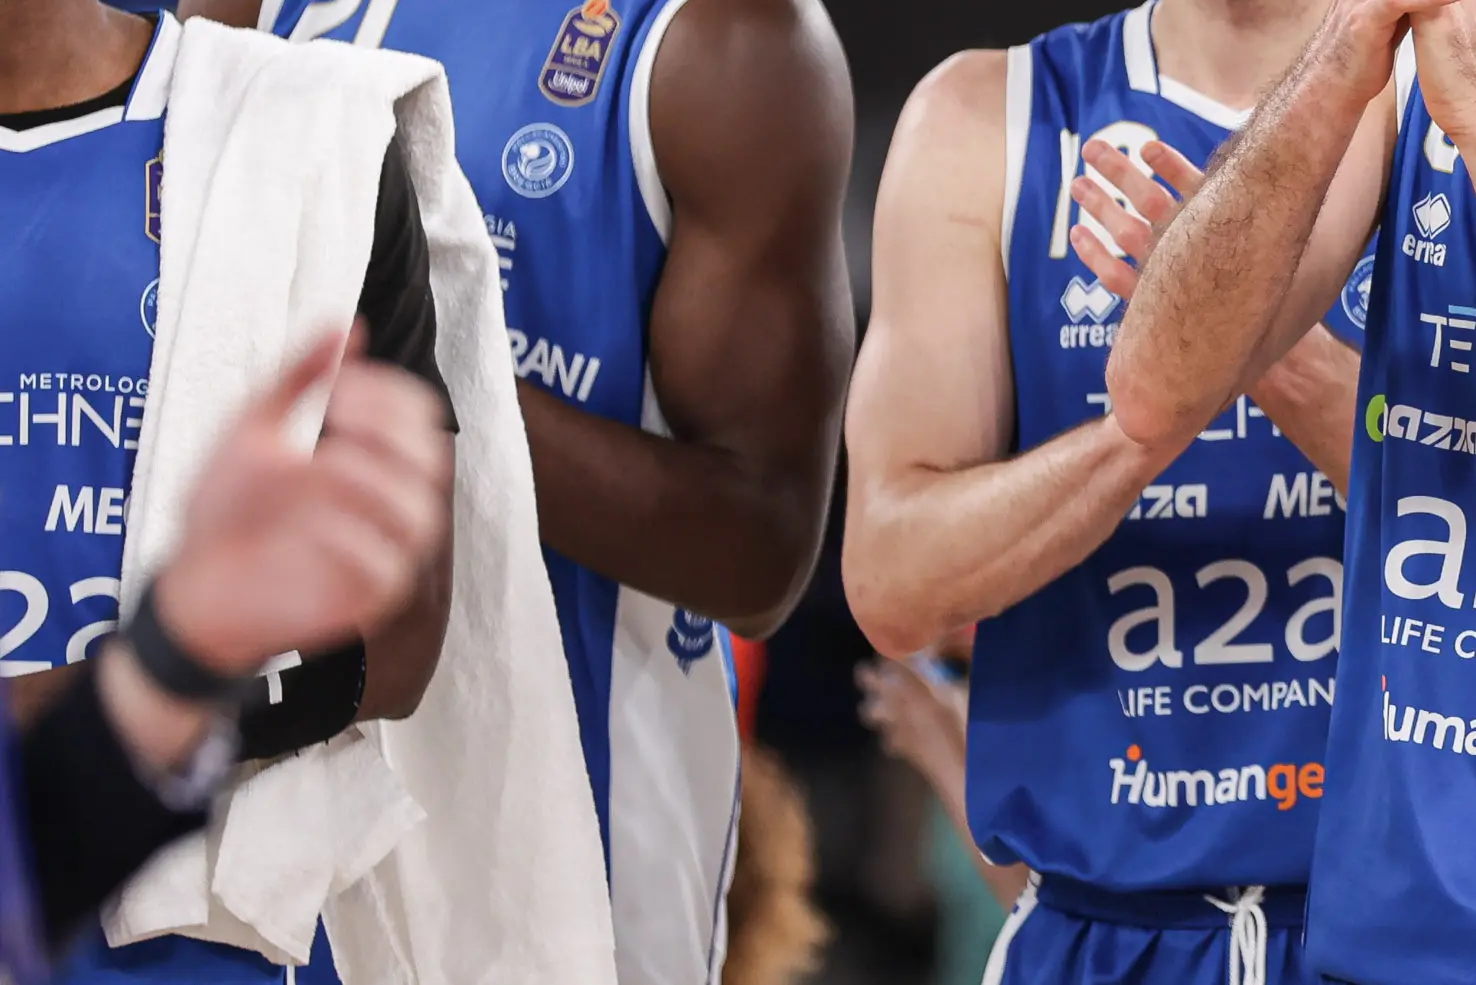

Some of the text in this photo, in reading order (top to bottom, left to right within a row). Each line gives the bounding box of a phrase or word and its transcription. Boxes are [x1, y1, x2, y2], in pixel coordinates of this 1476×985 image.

[45, 484, 131, 535] ME
[1107, 557, 1343, 672] a2a
[1381, 615, 1445, 654] LIFE
[1109, 744, 1326, 810] Humange
